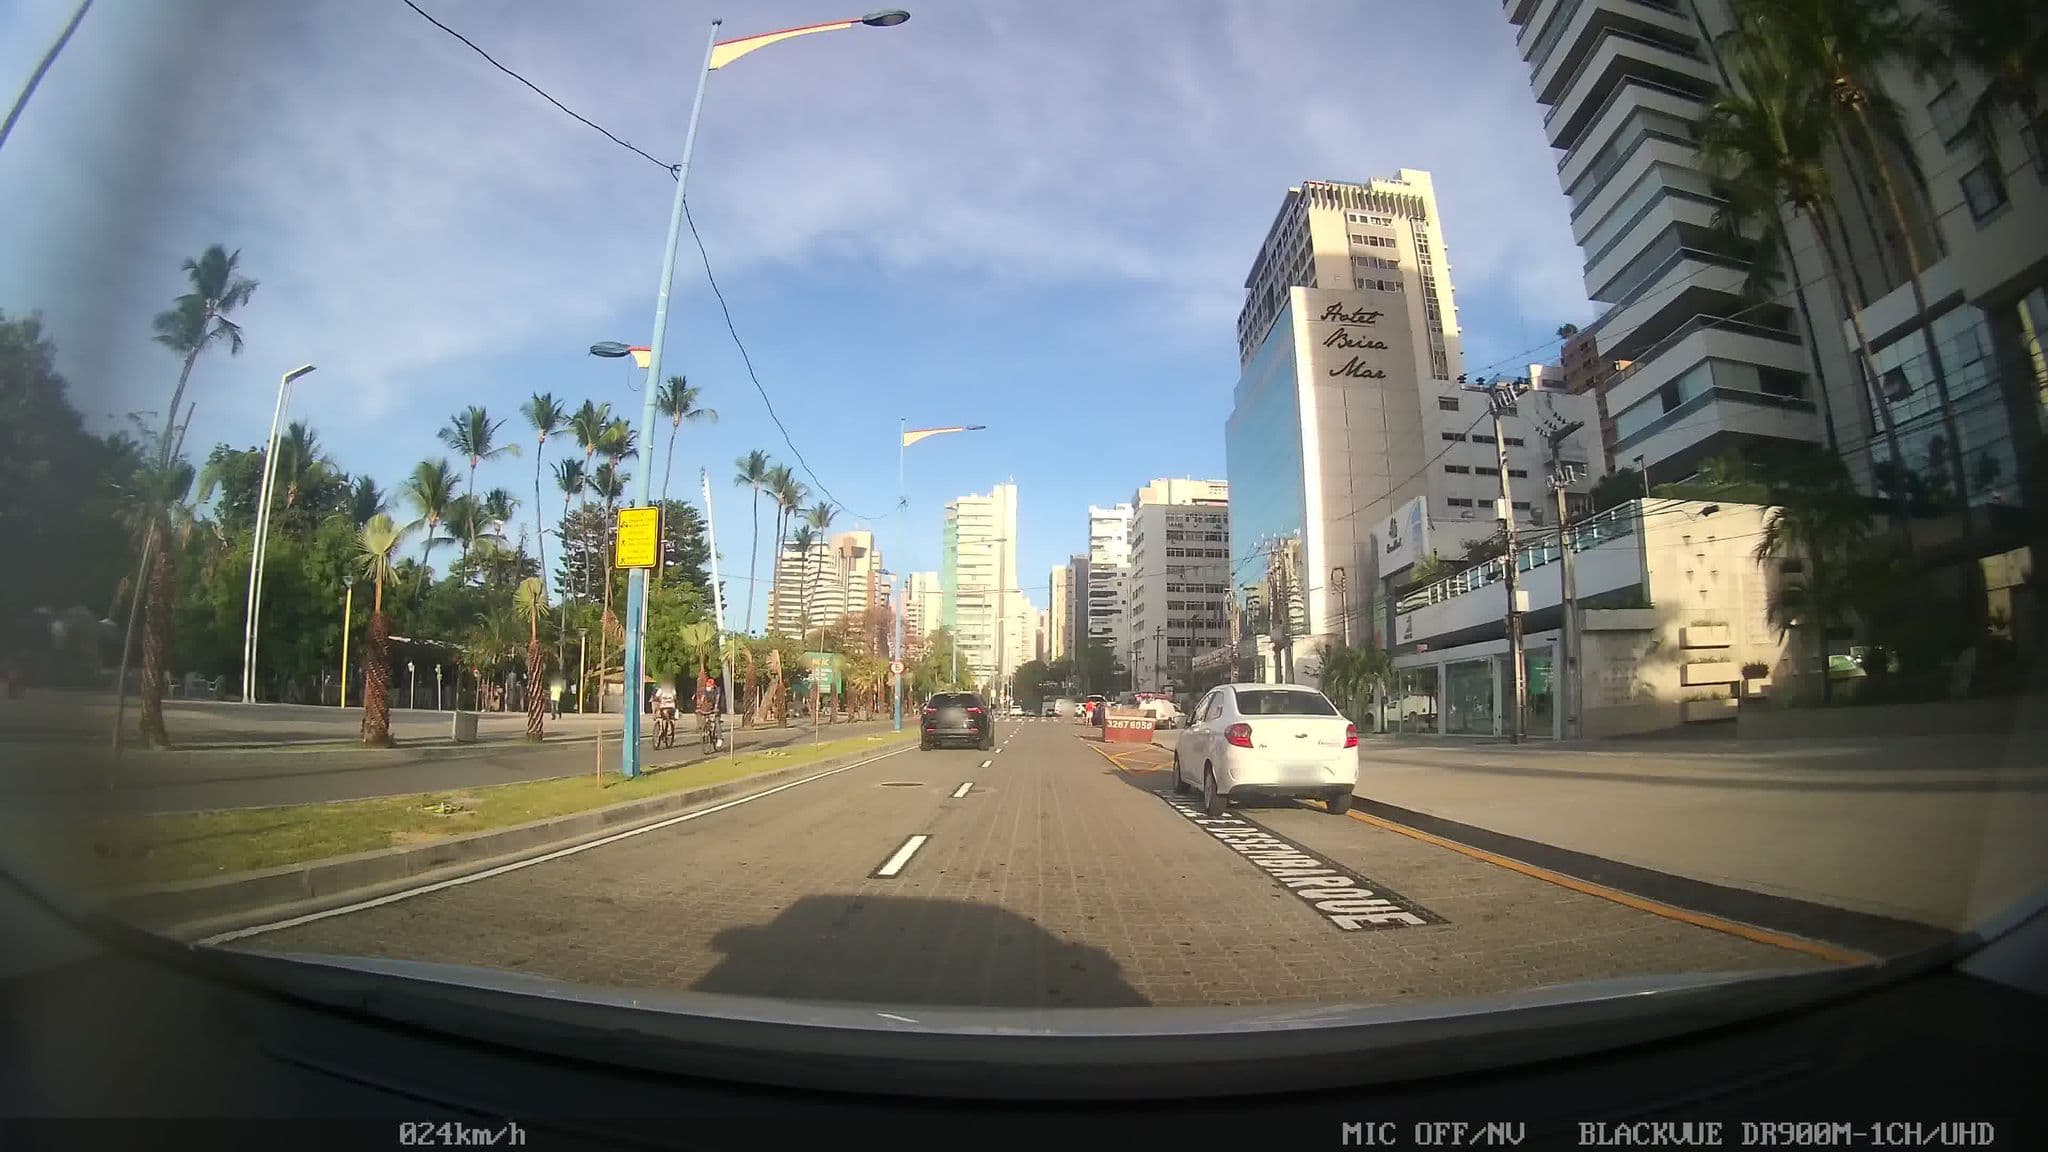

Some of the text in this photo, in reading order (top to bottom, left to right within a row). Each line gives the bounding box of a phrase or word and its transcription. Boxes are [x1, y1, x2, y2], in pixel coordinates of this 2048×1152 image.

[1321, 302, 1384, 324] Hotel
[1323, 327, 1388, 349] Beira
[1329, 356, 1386, 378] Mar
[1206, 827, 1427, 930] DESEMBARQUE
